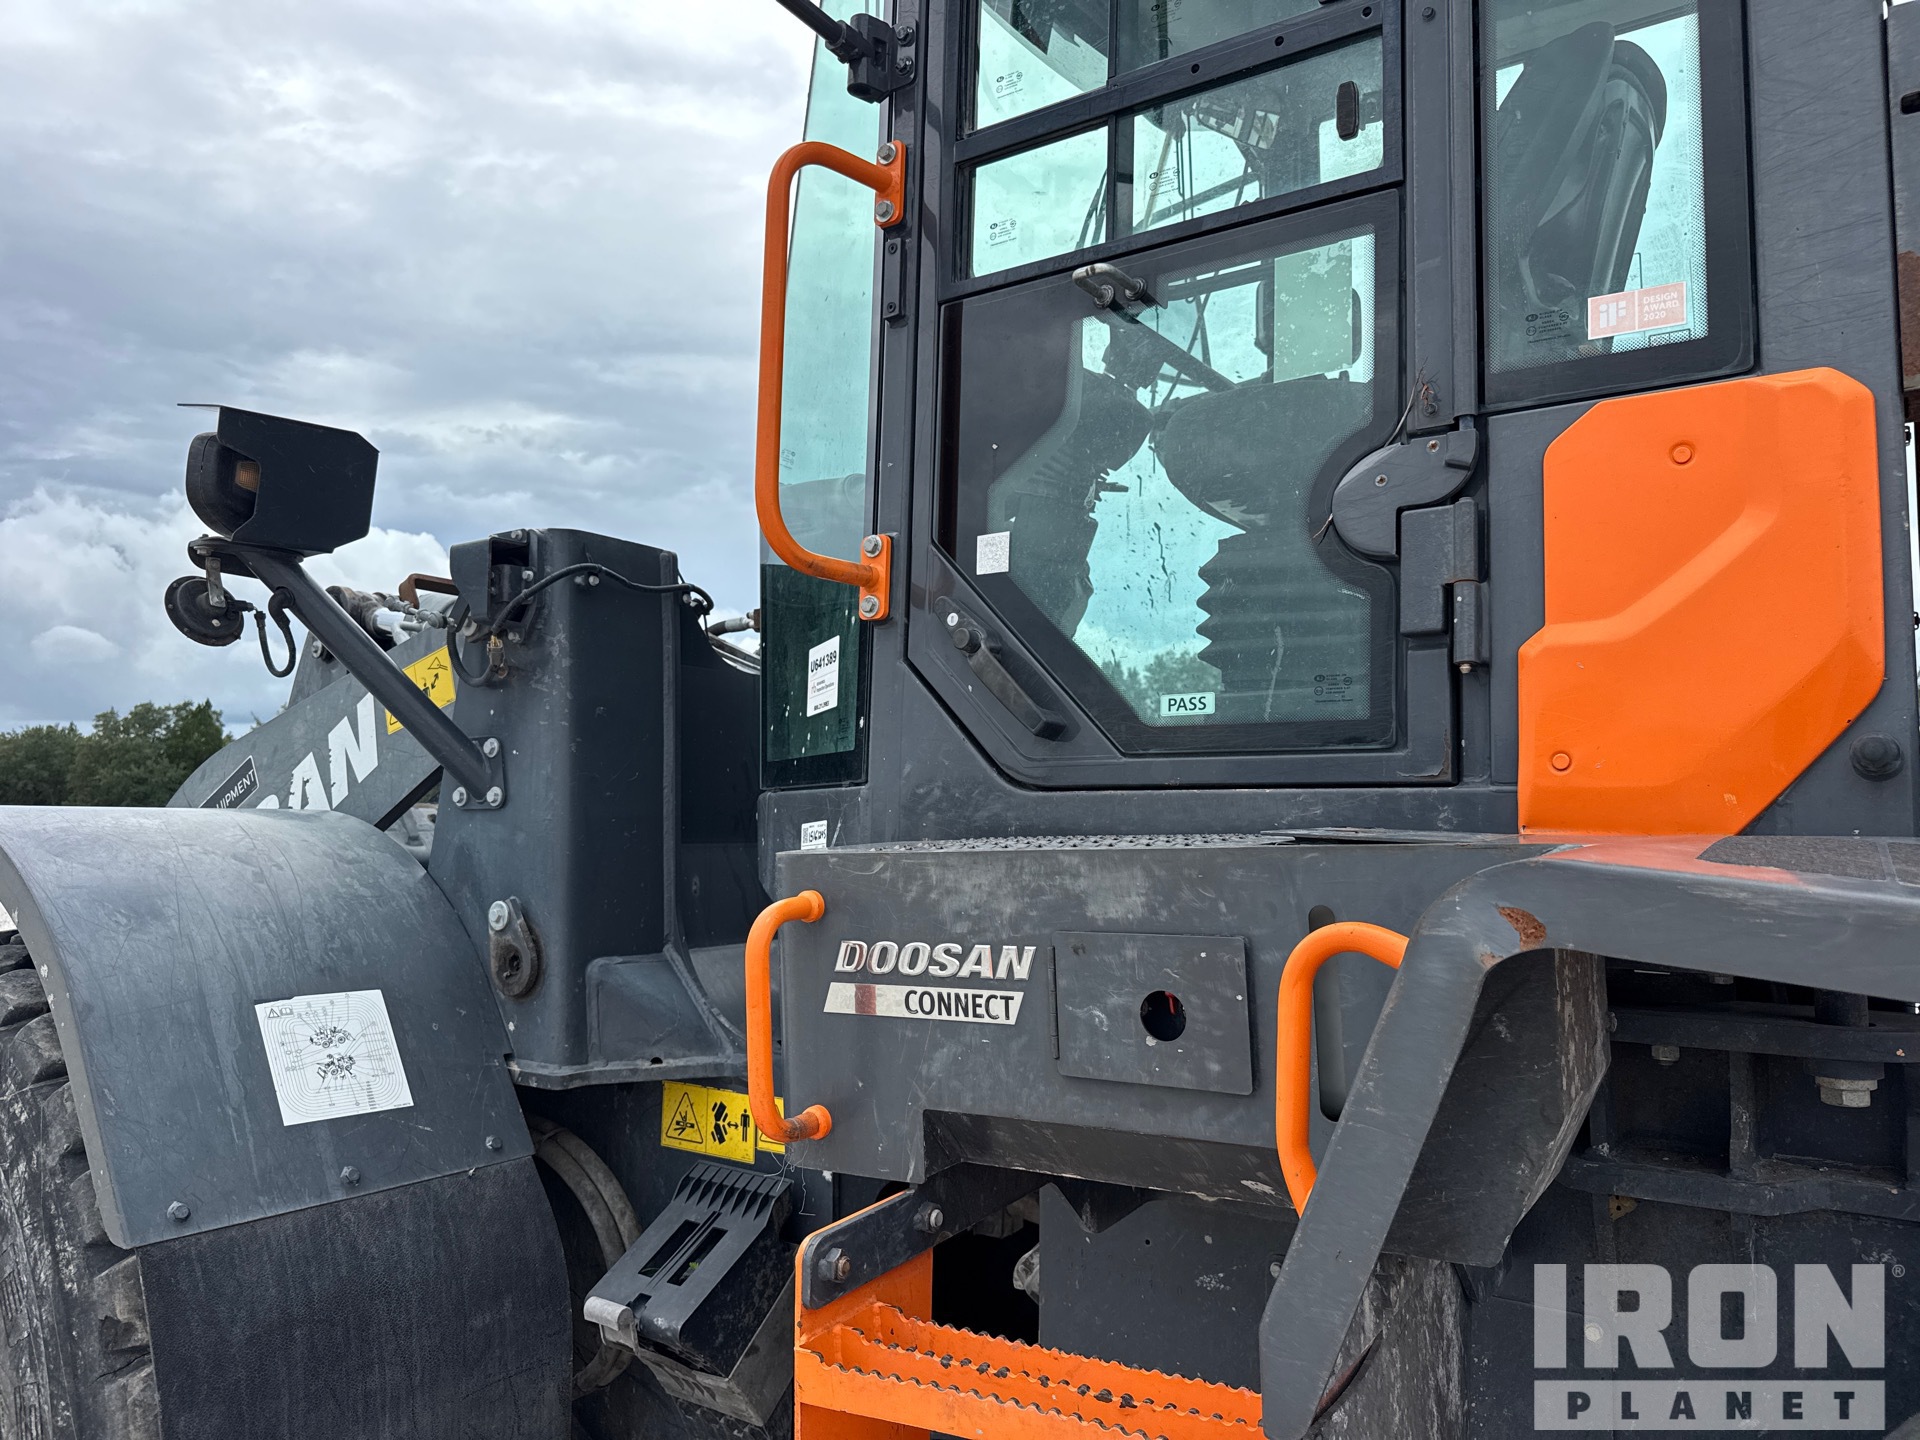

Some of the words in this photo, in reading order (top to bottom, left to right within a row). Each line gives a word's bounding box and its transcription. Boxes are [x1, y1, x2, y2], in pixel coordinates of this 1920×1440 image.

[1643, 291, 1678, 305] DESIGN
[1643, 300, 1680, 313] AWARD
[1643, 310, 1667, 321] 2020
[810, 650, 837, 673] U641389
[1167, 696, 1207, 712] PASS
[256, 692, 379, 810] AN
[834, 940, 1037, 980] DOOSAN
[904, 989, 1015, 1021] CONNECT
